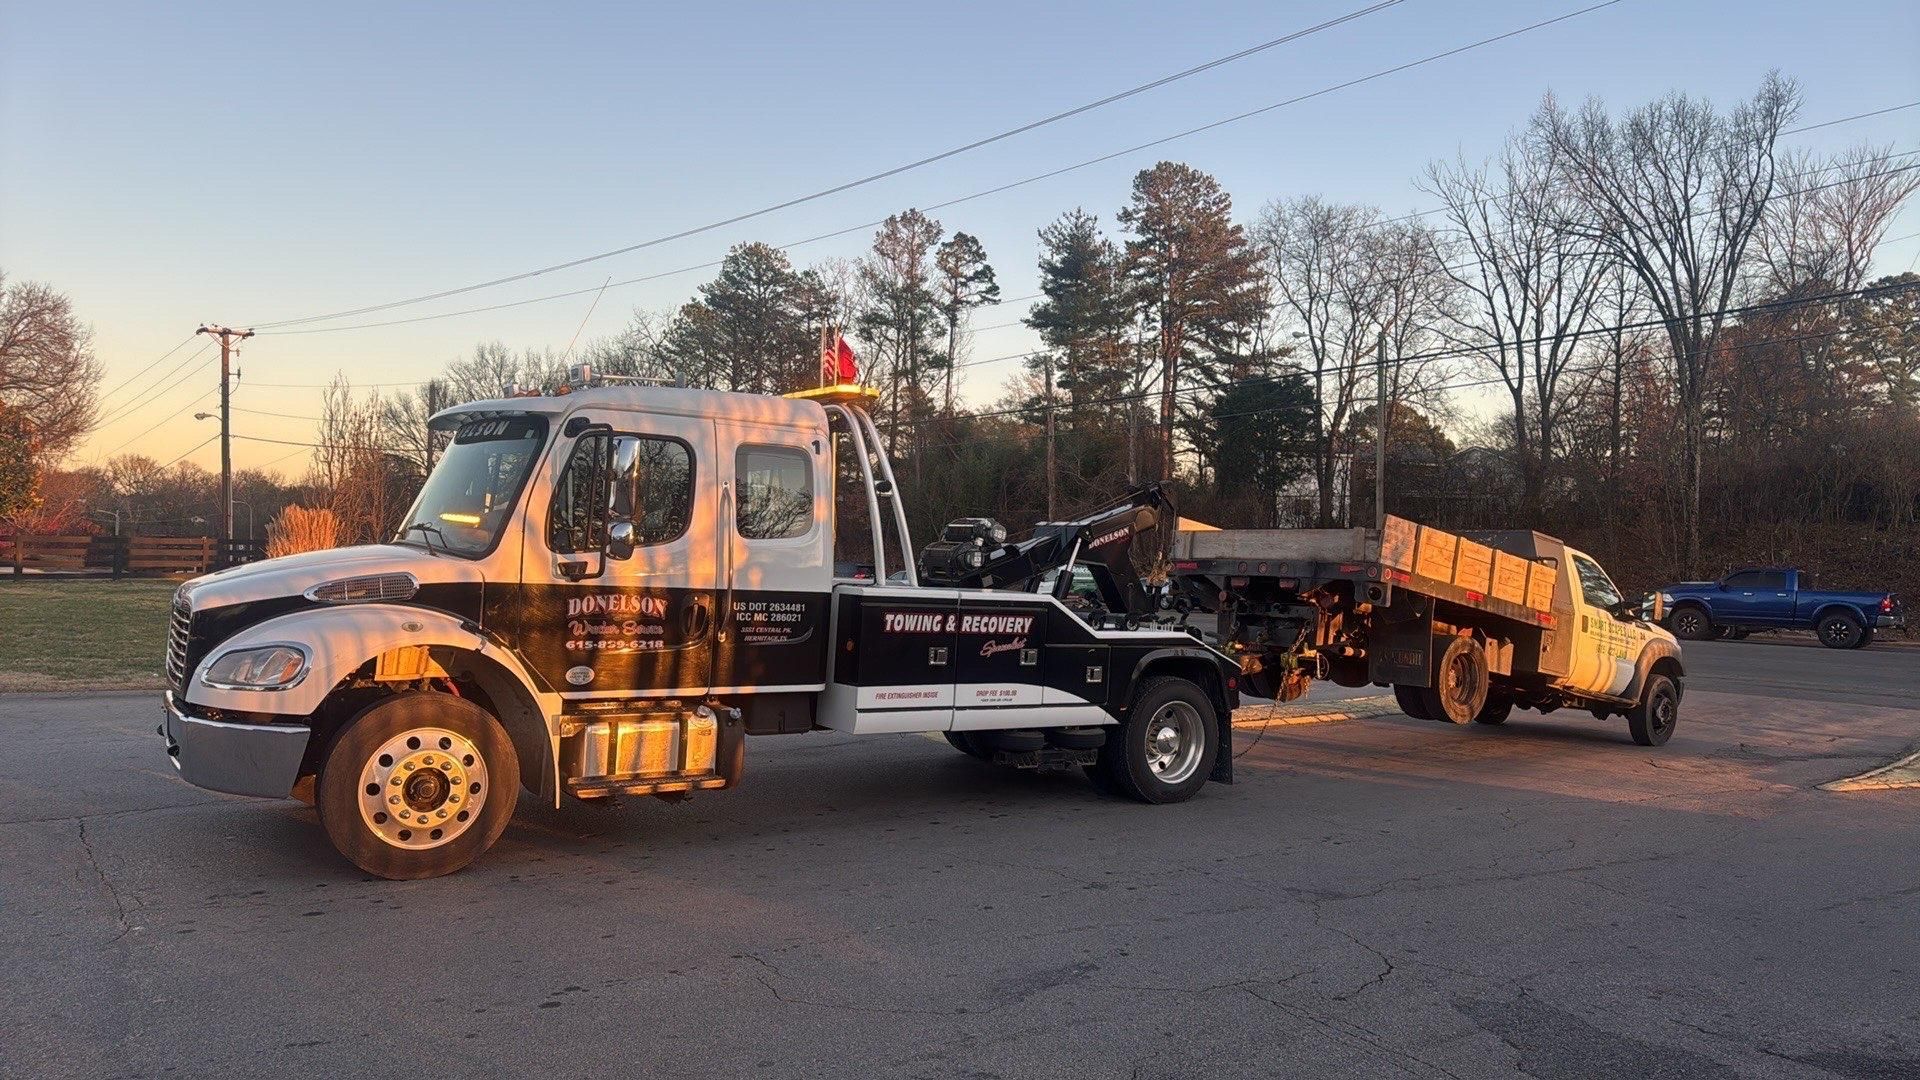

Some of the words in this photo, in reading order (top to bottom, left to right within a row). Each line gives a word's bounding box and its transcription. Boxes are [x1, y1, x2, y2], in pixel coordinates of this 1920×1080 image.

[812, 440, 820, 455] 1
[1089, 527, 1129, 549] DONELSON
[567, 594, 667, 620] DONELSON
[733, 602, 746, 611] US
[748, 602, 767, 611] DOT
[769, 603, 806, 612] 2634481
[736, 613, 751, 621] ICC
[753, 613, 768, 621] MC
[884, 613, 943, 632] TOWING
[945, 615, 956, 632] &
[961, 616, 1034, 633] RECOVERY
[875, 692, 887, 700] FIRE
